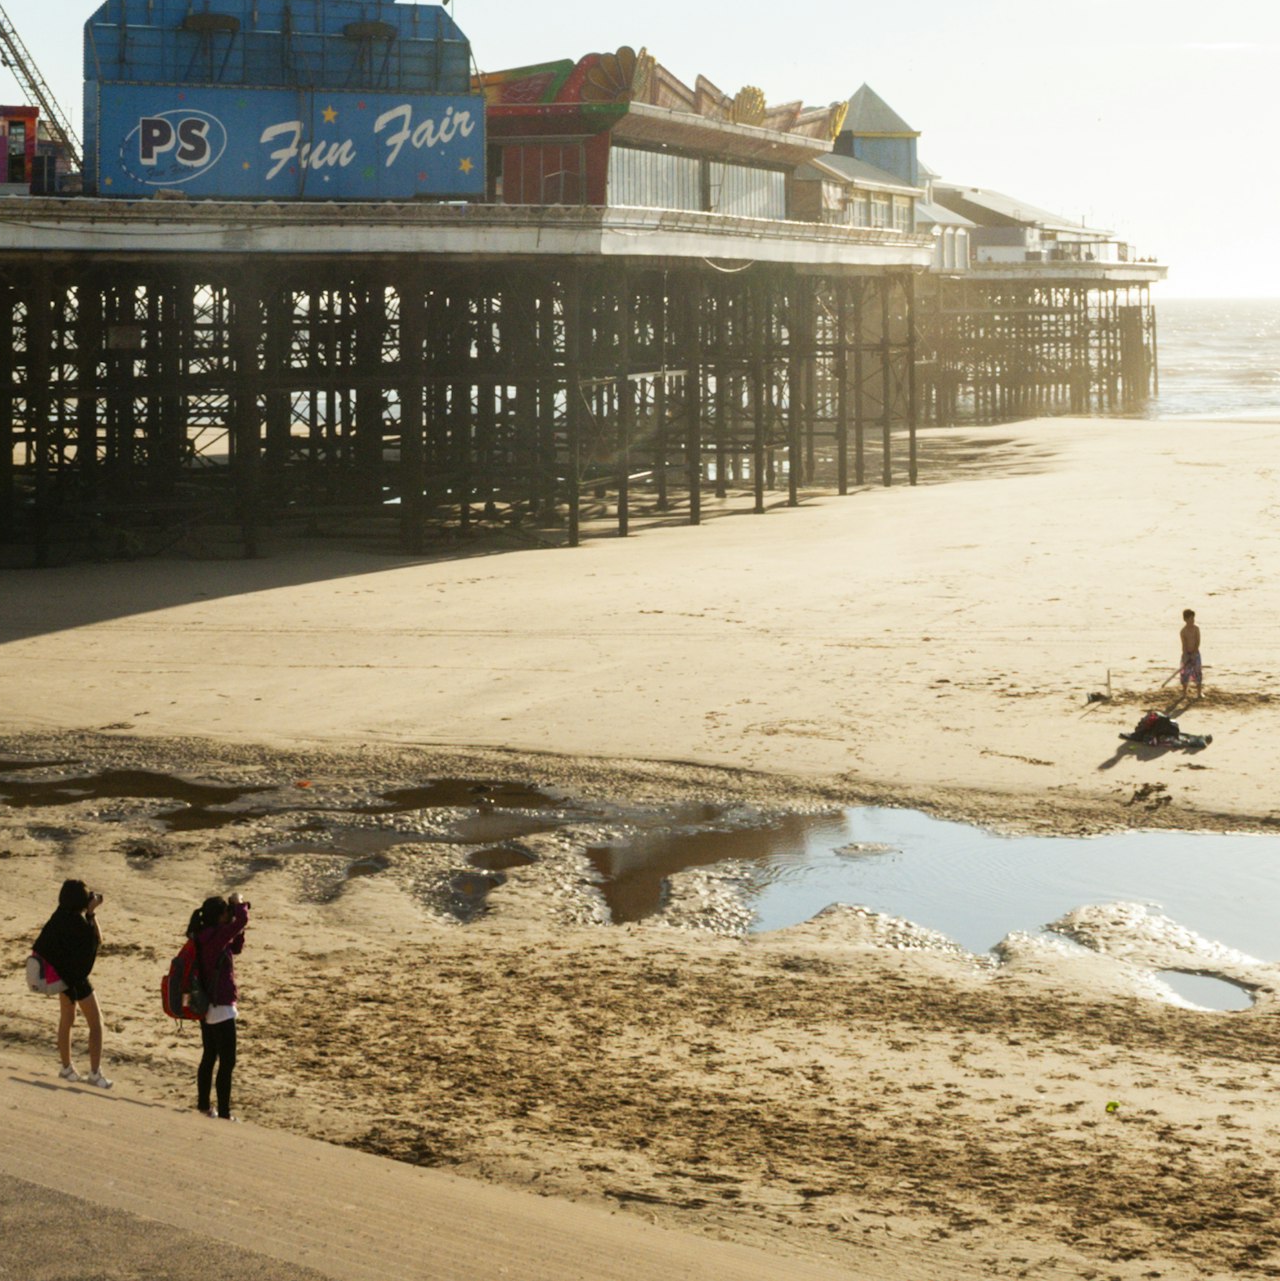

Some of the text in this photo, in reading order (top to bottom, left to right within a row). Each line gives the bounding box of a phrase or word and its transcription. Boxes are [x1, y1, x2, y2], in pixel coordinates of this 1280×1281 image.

[139, 116, 212, 168] PS
[256, 103, 475, 181] Fun Fair
